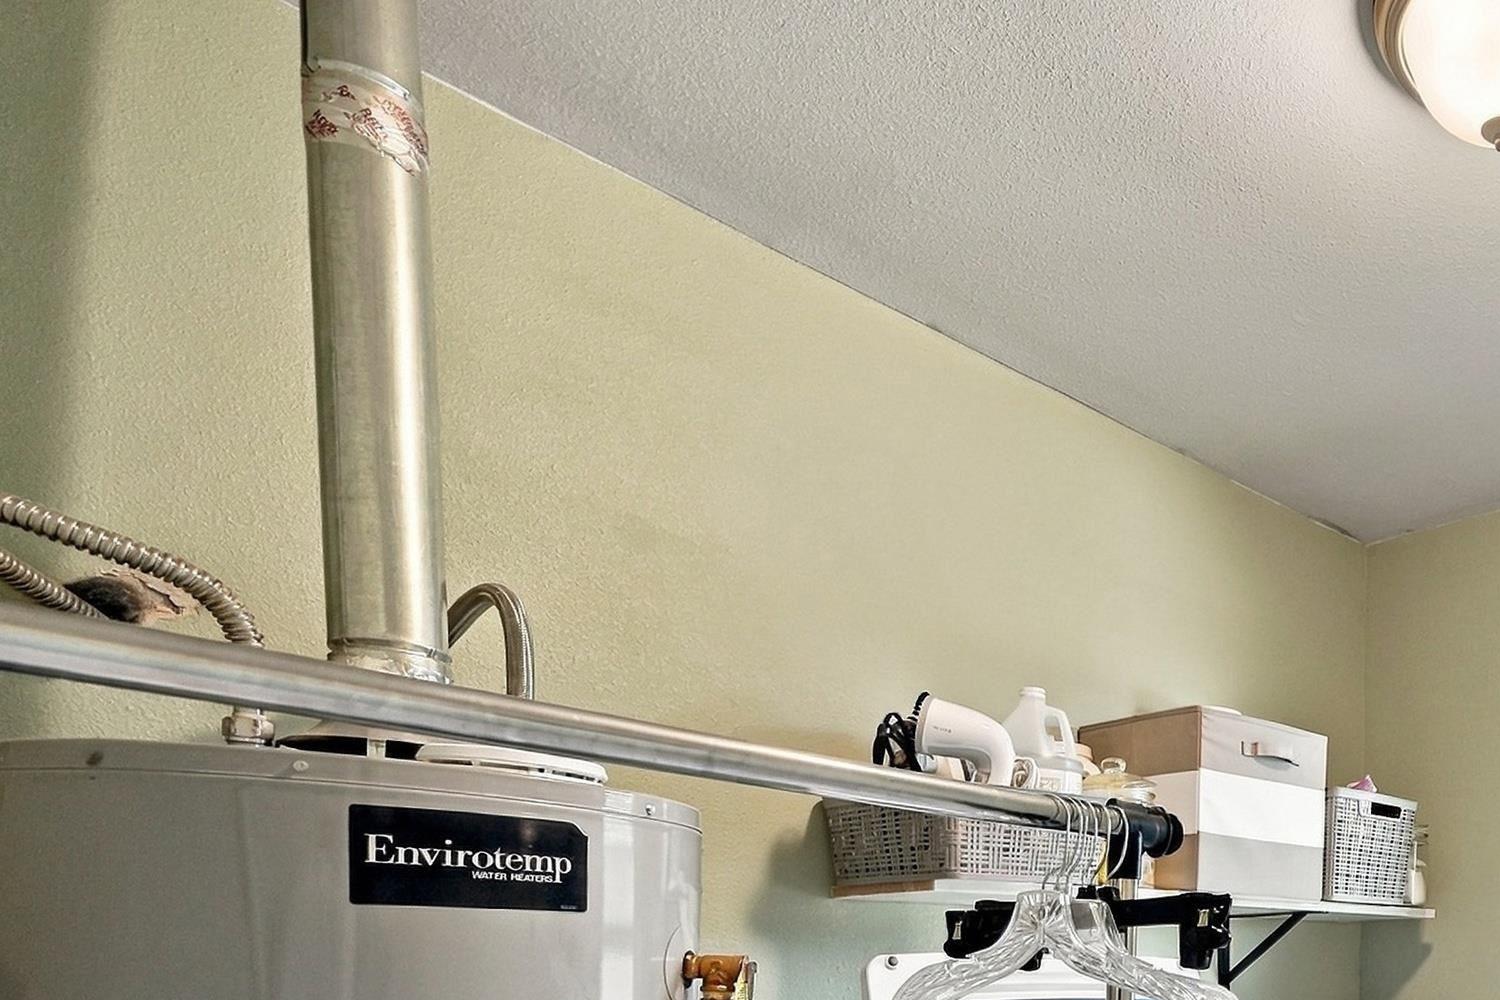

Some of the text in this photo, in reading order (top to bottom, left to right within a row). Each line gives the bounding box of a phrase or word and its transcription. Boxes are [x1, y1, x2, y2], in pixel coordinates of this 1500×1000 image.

[364, 832, 573, 884] Envirotemp
[472, 870, 554, 883] WATER HEATERS
